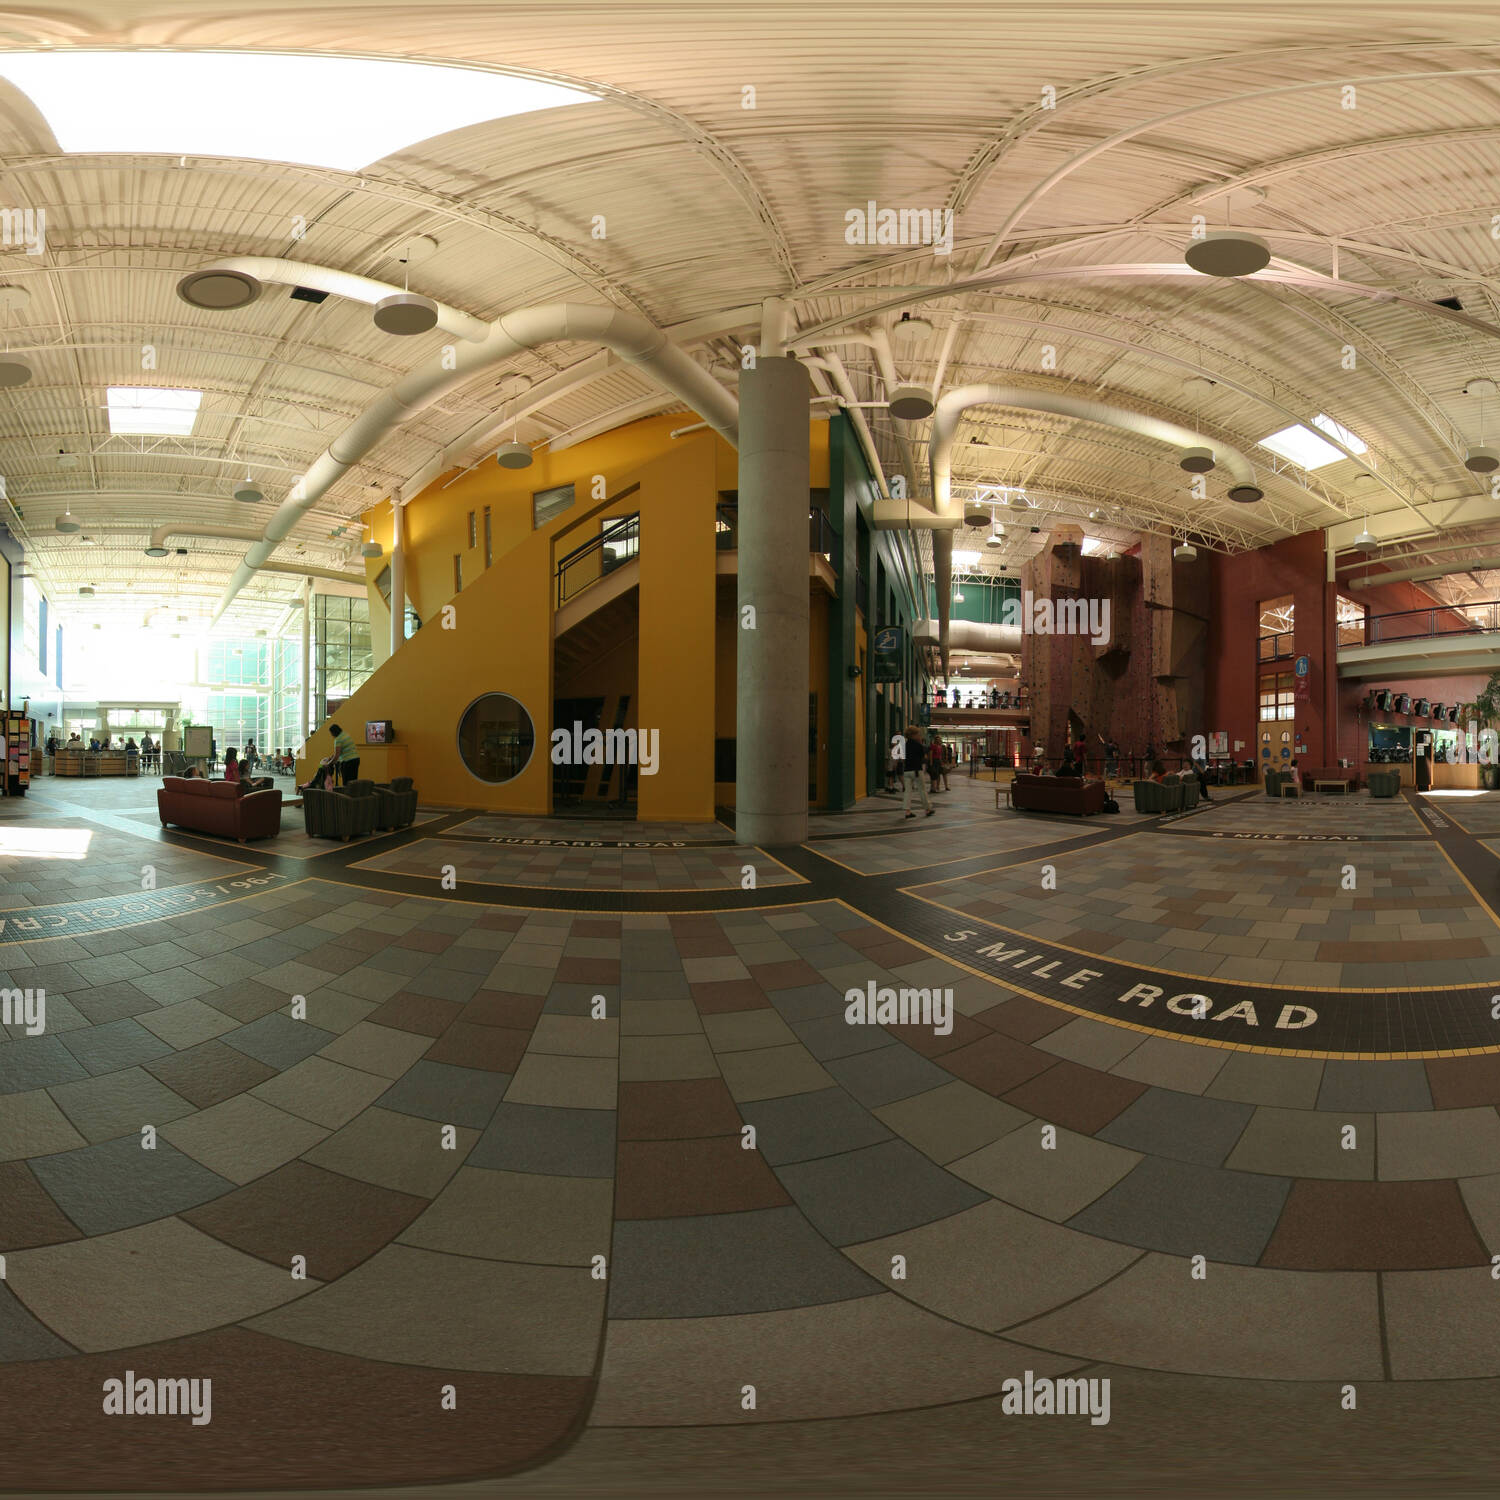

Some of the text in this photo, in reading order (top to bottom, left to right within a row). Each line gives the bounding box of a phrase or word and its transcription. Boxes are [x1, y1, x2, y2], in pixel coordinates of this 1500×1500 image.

[488, 837, 603, 847] HUBBARD
[0, 887, 217, 933] SCHOOLCR
[943, 929, 1319, 1031] 5 MILE ROAD
